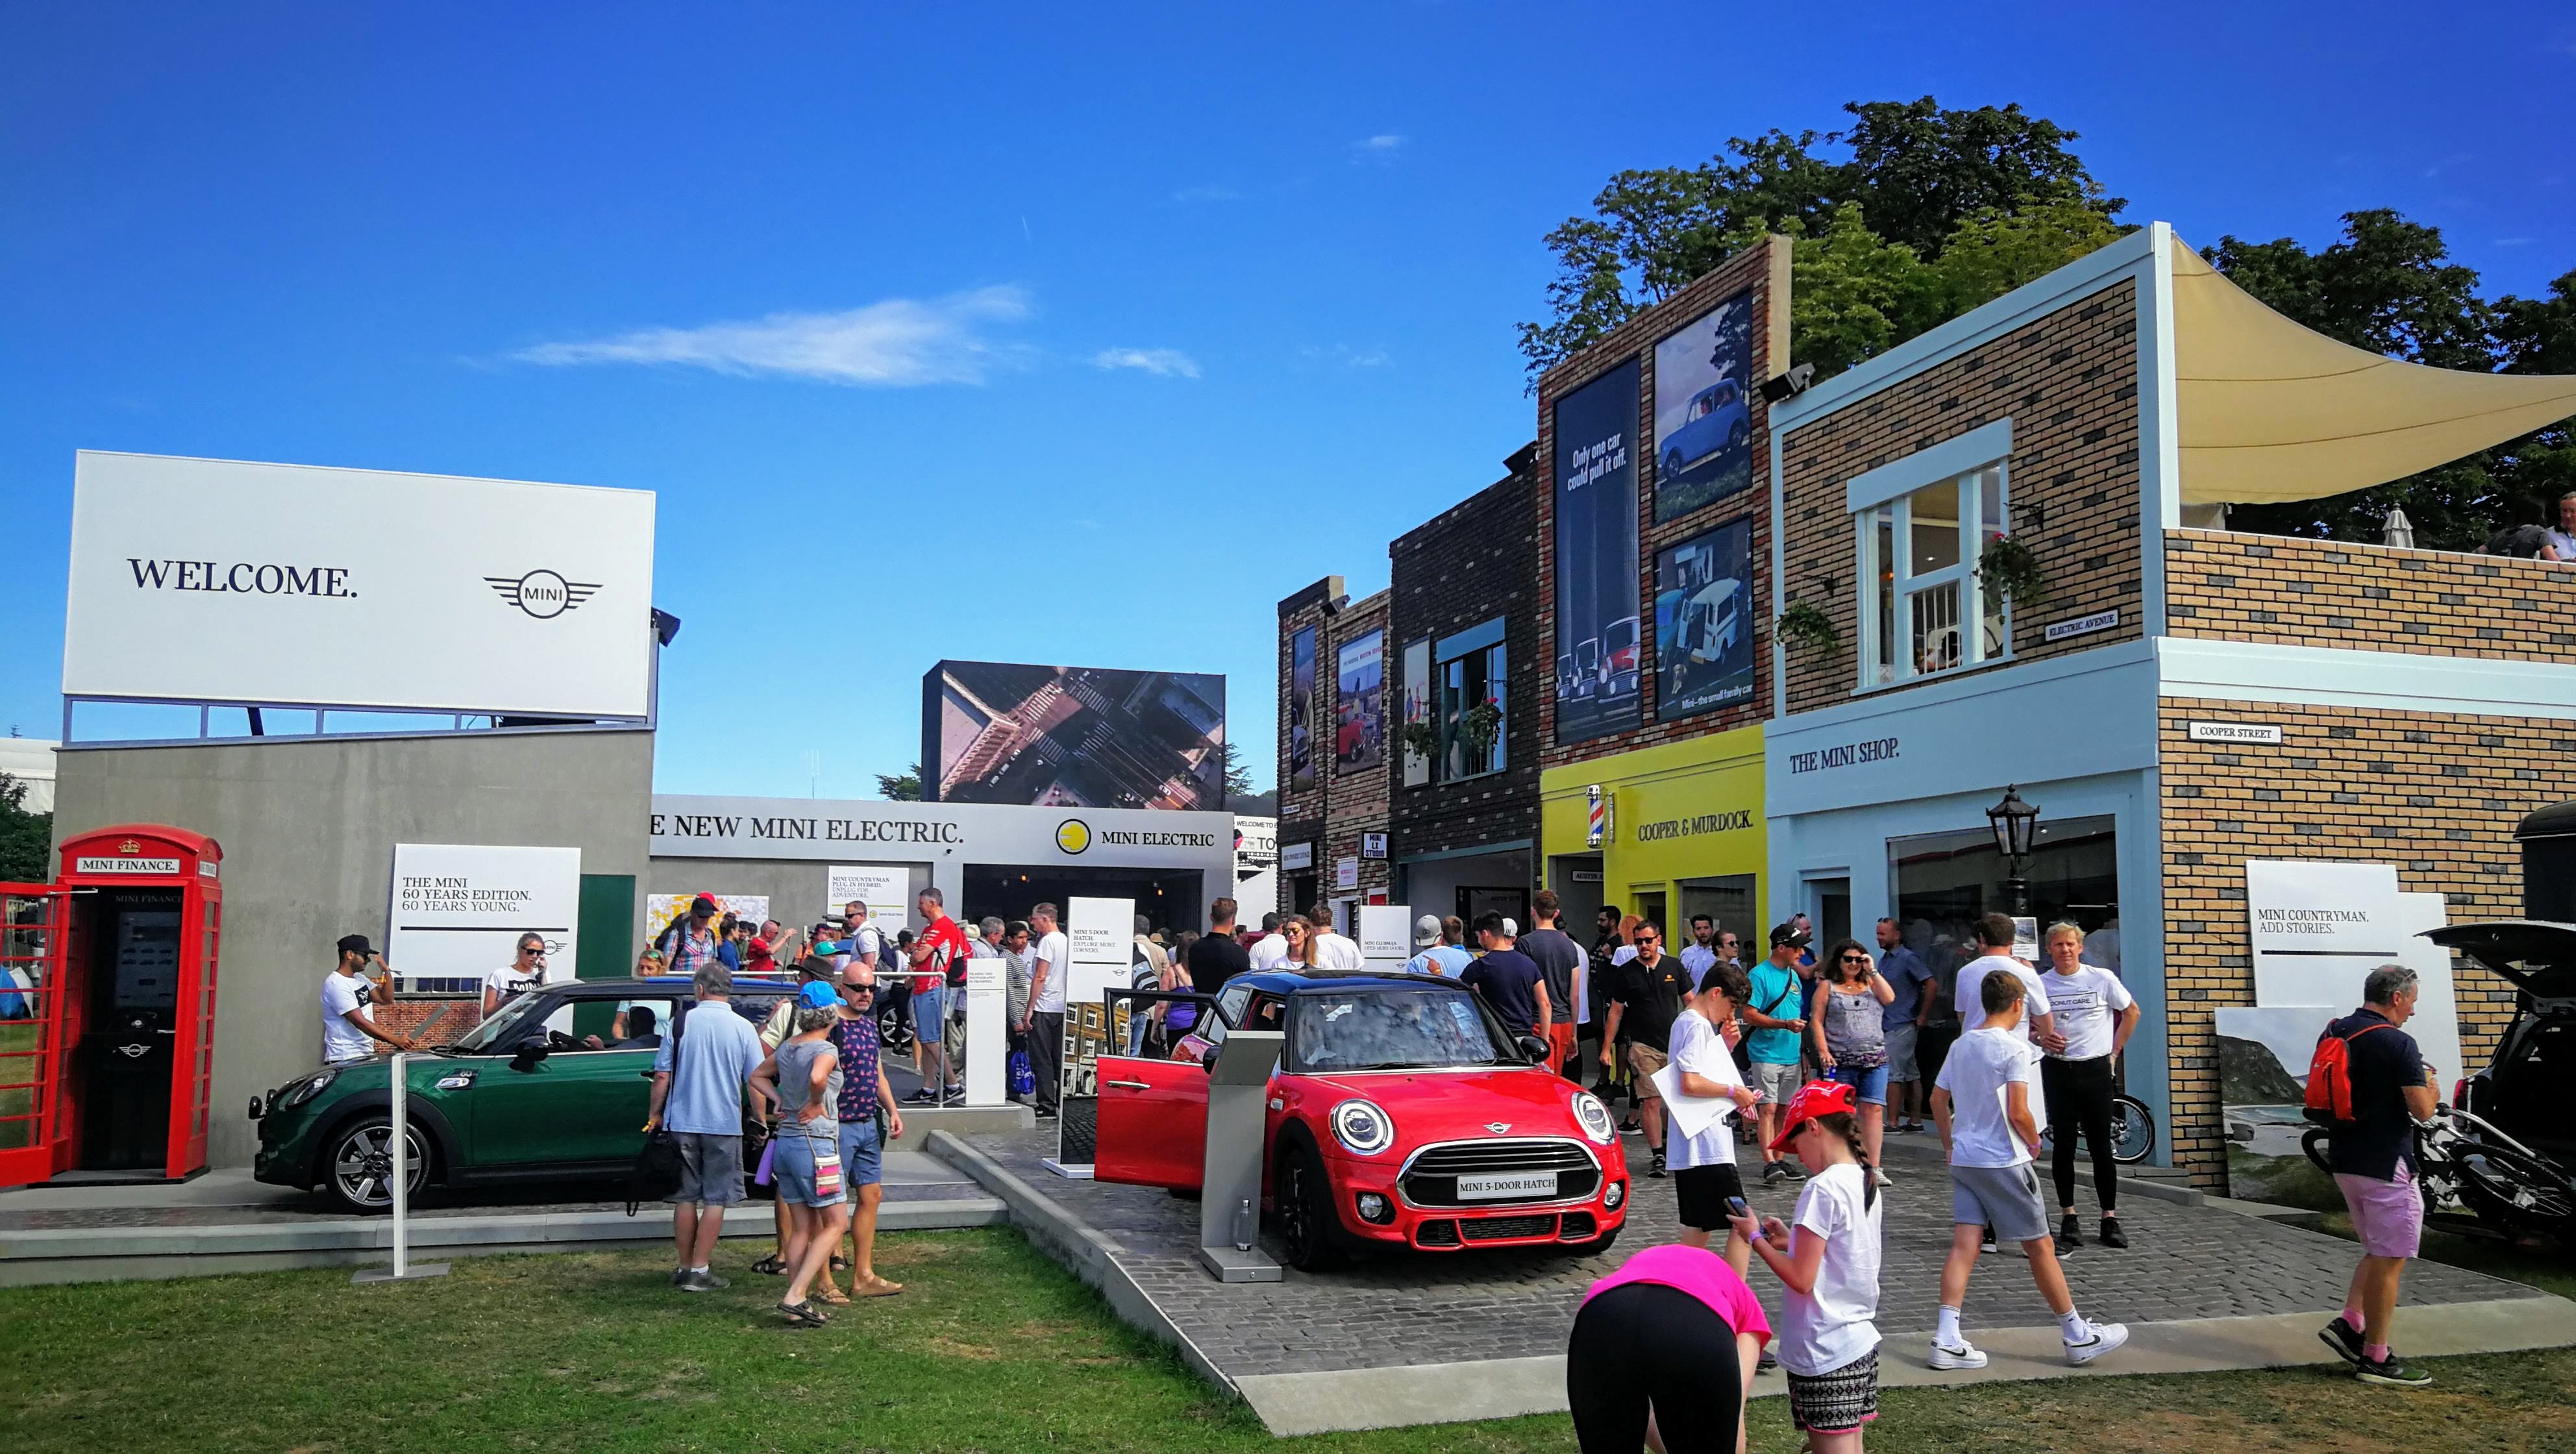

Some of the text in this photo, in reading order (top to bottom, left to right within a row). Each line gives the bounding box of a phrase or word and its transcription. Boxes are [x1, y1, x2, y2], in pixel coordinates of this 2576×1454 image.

[1572, 432, 1621, 469] Only one car
[1567, 447, 1626, 491] could pull it off.
[127, 558, 358, 598] WELCOME.
[524, 587, 564, 602] MINI
[2049, 614, 2114, 637] ELECTRIC AVENUE
[1708, 691, 1724, 703] small
[1724, 687, 1742, 700] family
[2199, 726, 2272, 739] COOPER STREET
[1789, 737, 1900, 774] THE MINI SHOP.
[673, 815, 742, 838] NEW
[750, 817, 818, 839] MINI
[825, 820, 964, 844] ELECTRIC.
[1638, 809, 1754, 842] COOPER & MURDOCK.
[1102, 831, 1215, 846] MINI ELECTRIC
[1365, 849, 1385, 857] STUDIO
[82, 860, 175, 871] MINI FINANCE.
[402, 877, 468, 889] THE MINI
[115, 894, 139, 903] MINI
[402, 889, 532, 901] 60 YEARS EDITION.
[402, 901, 520, 913] 60 YEARS YOUNG.
[2258, 909, 2370, 922] MINI COUNTRYMAN.
[2259, 922, 2335, 934] ADD STORIES.
[1459, 1179, 1555, 1192] MINI 5-DOOR HATCH
